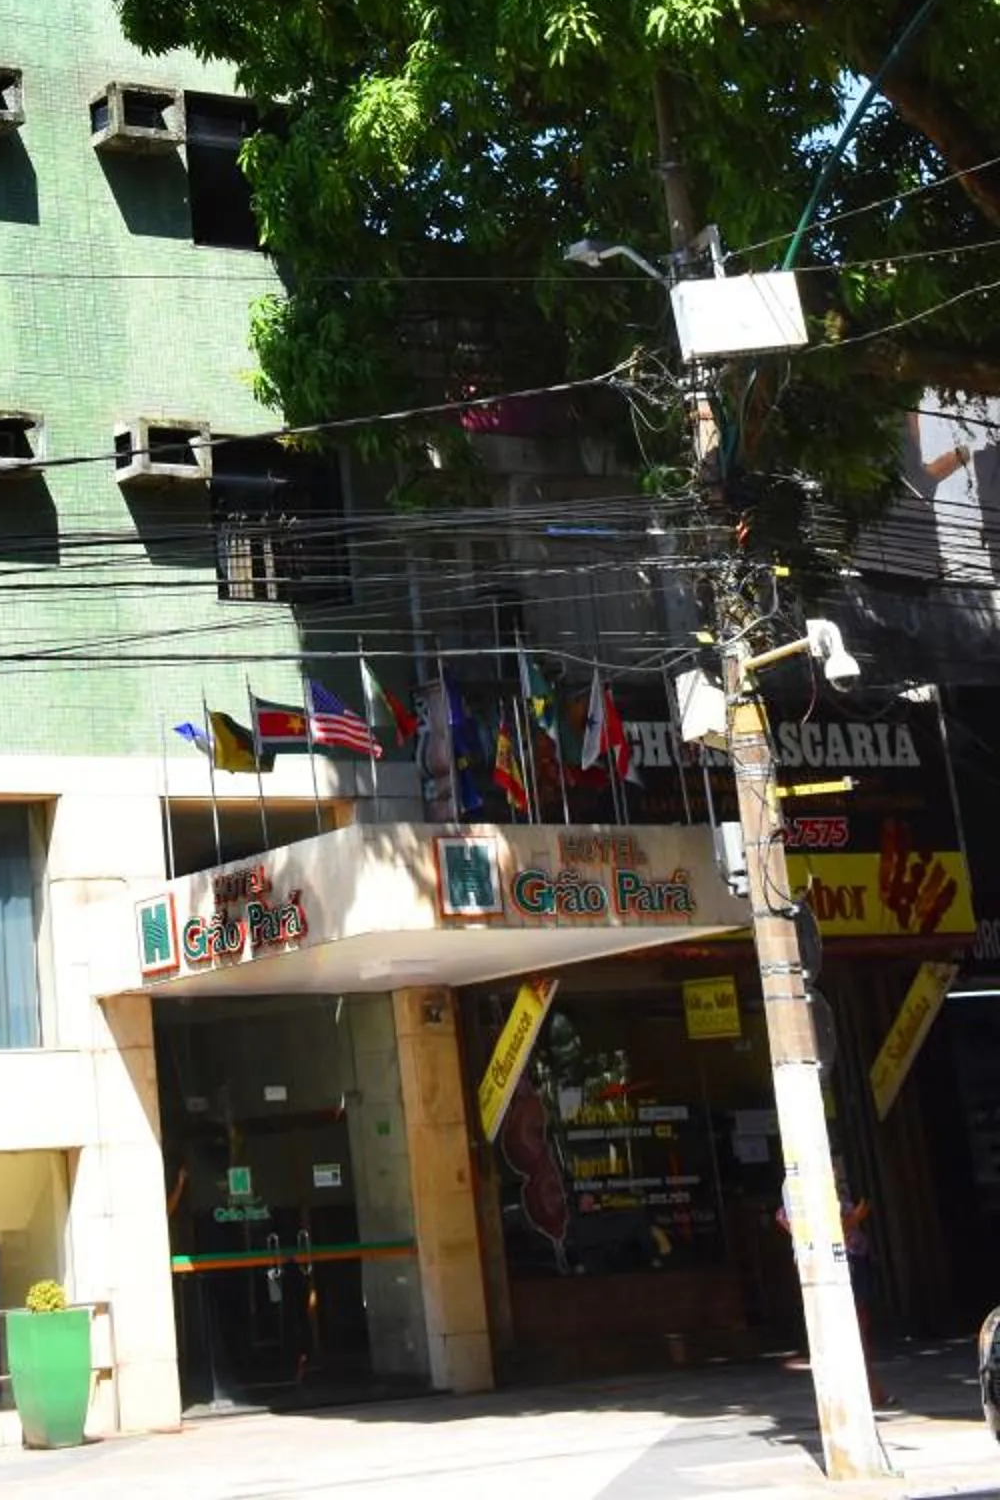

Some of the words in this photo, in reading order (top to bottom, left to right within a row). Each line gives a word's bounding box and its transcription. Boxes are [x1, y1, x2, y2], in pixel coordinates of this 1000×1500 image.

[558, 834, 646, 866] HOTEL
[512, 868, 608, 916] Grão
[612, 867, 696, 917] Pará
[184, 910, 248, 962] Grão
[248, 890, 309, 948] Pará
